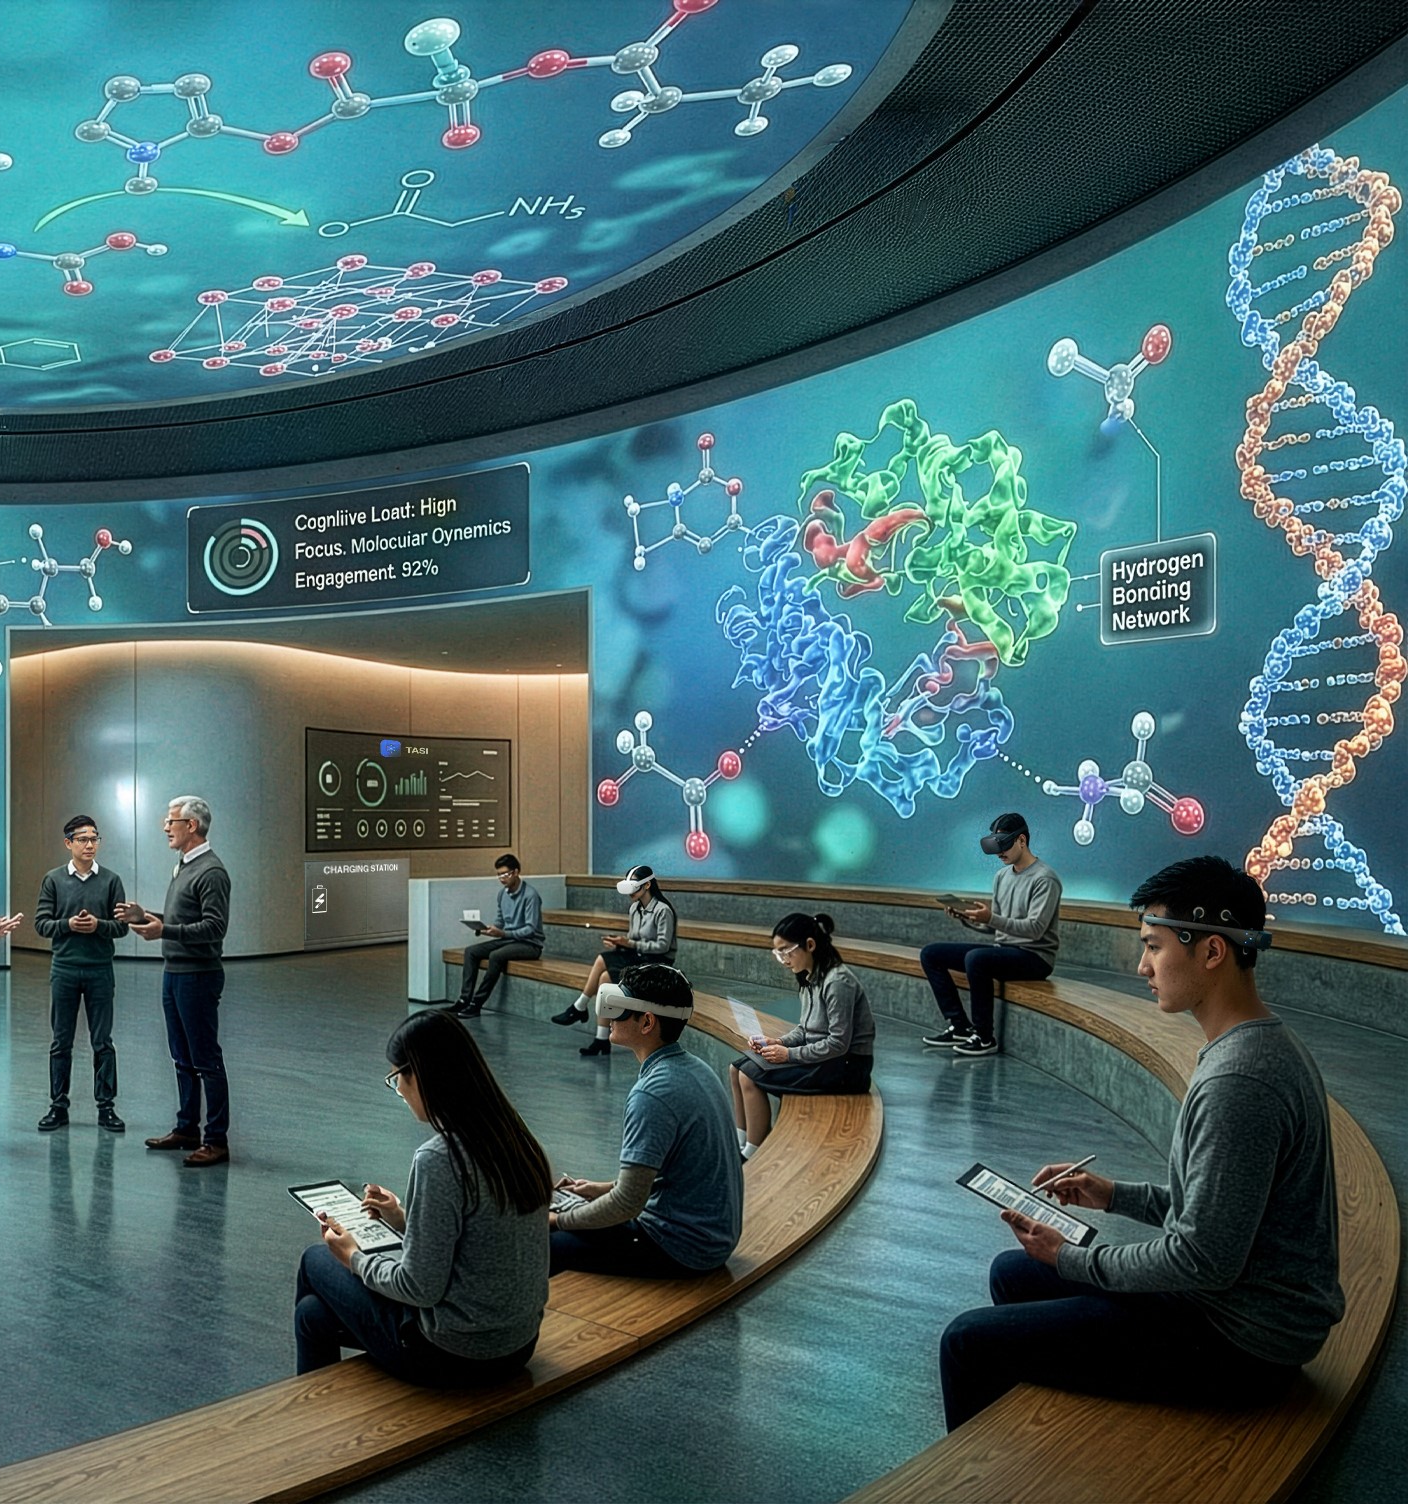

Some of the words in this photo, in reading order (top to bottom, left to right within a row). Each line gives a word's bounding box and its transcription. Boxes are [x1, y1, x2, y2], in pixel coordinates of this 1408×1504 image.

[401, 558, 439, 578] 92%
[1112, 552, 1204, 584] Hydrogen
[1112, 604, 1191, 631] Network
[405, 746, 429, 755] TASI
[323, 864, 370, 875] CHARGING
[370, 863, 399, 873] STATION
